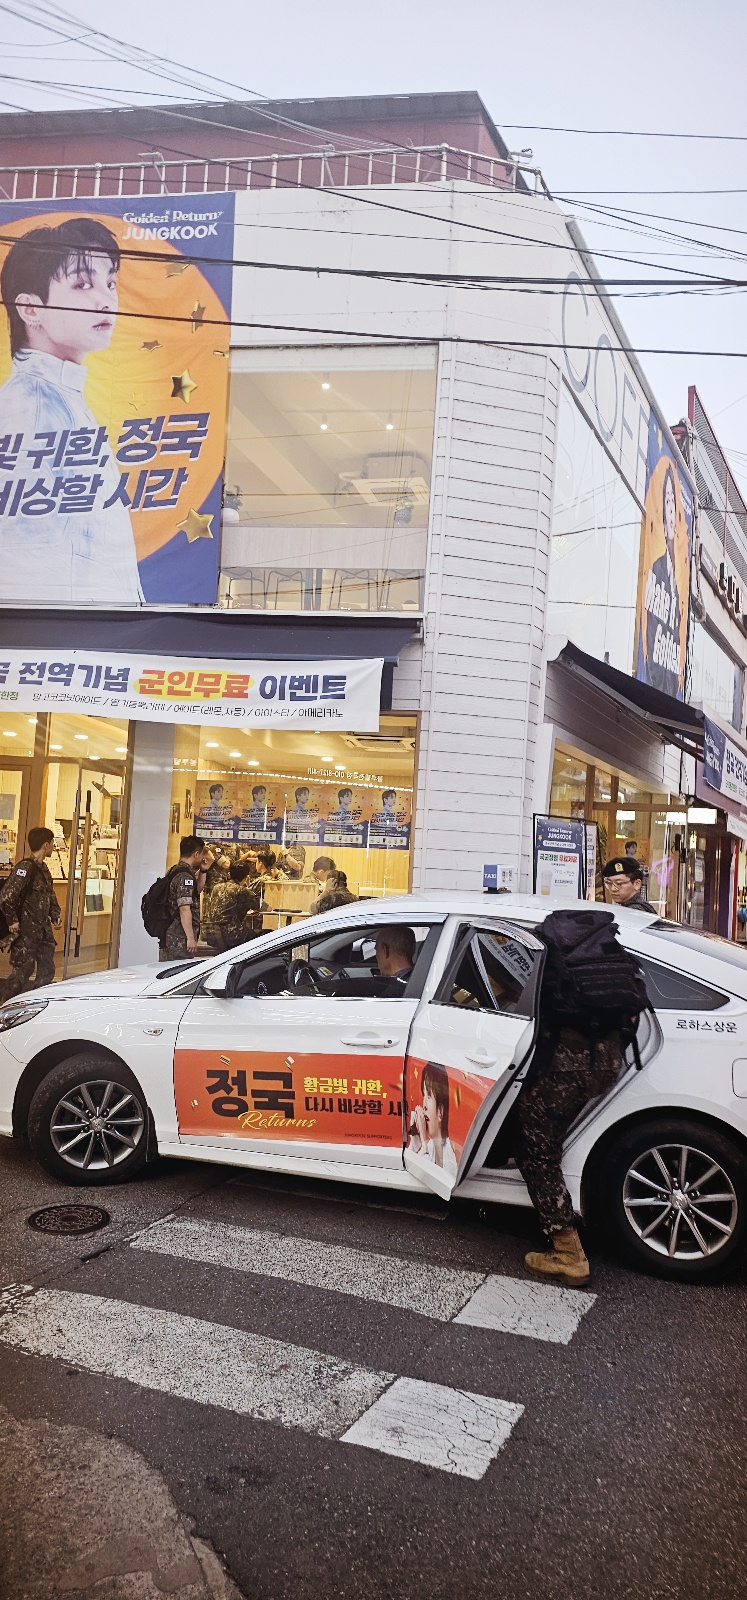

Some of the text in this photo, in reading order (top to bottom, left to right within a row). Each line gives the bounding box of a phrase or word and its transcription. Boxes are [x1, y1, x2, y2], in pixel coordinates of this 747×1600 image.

[122, 212, 169, 224] Golden
[122, 222, 219, 241] JUNGKOOK
[26, 425, 111, 470] 귀환,
[115, 412, 211, 466] 정국
[103, 467, 190, 512] 시간
[645, 568, 671, 625] Make
[18, 661, 131, 693] 전역기념
[138, 669, 251, 699] 군인무료
[259, 674, 347, 702] 이벤트
[298, 707, 344, 718] 아메리카노
[675, 1019, 738, 1034] 로하스상운
[206, 1069, 296, 1119] 정국
[303, 1076, 388, 1099] 황금빛 귀환,
[304, 1096, 335, 1113] 다시
[338, 1097, 384, 1116] 비상할
[237, 1110, 317, 1130] Returns
